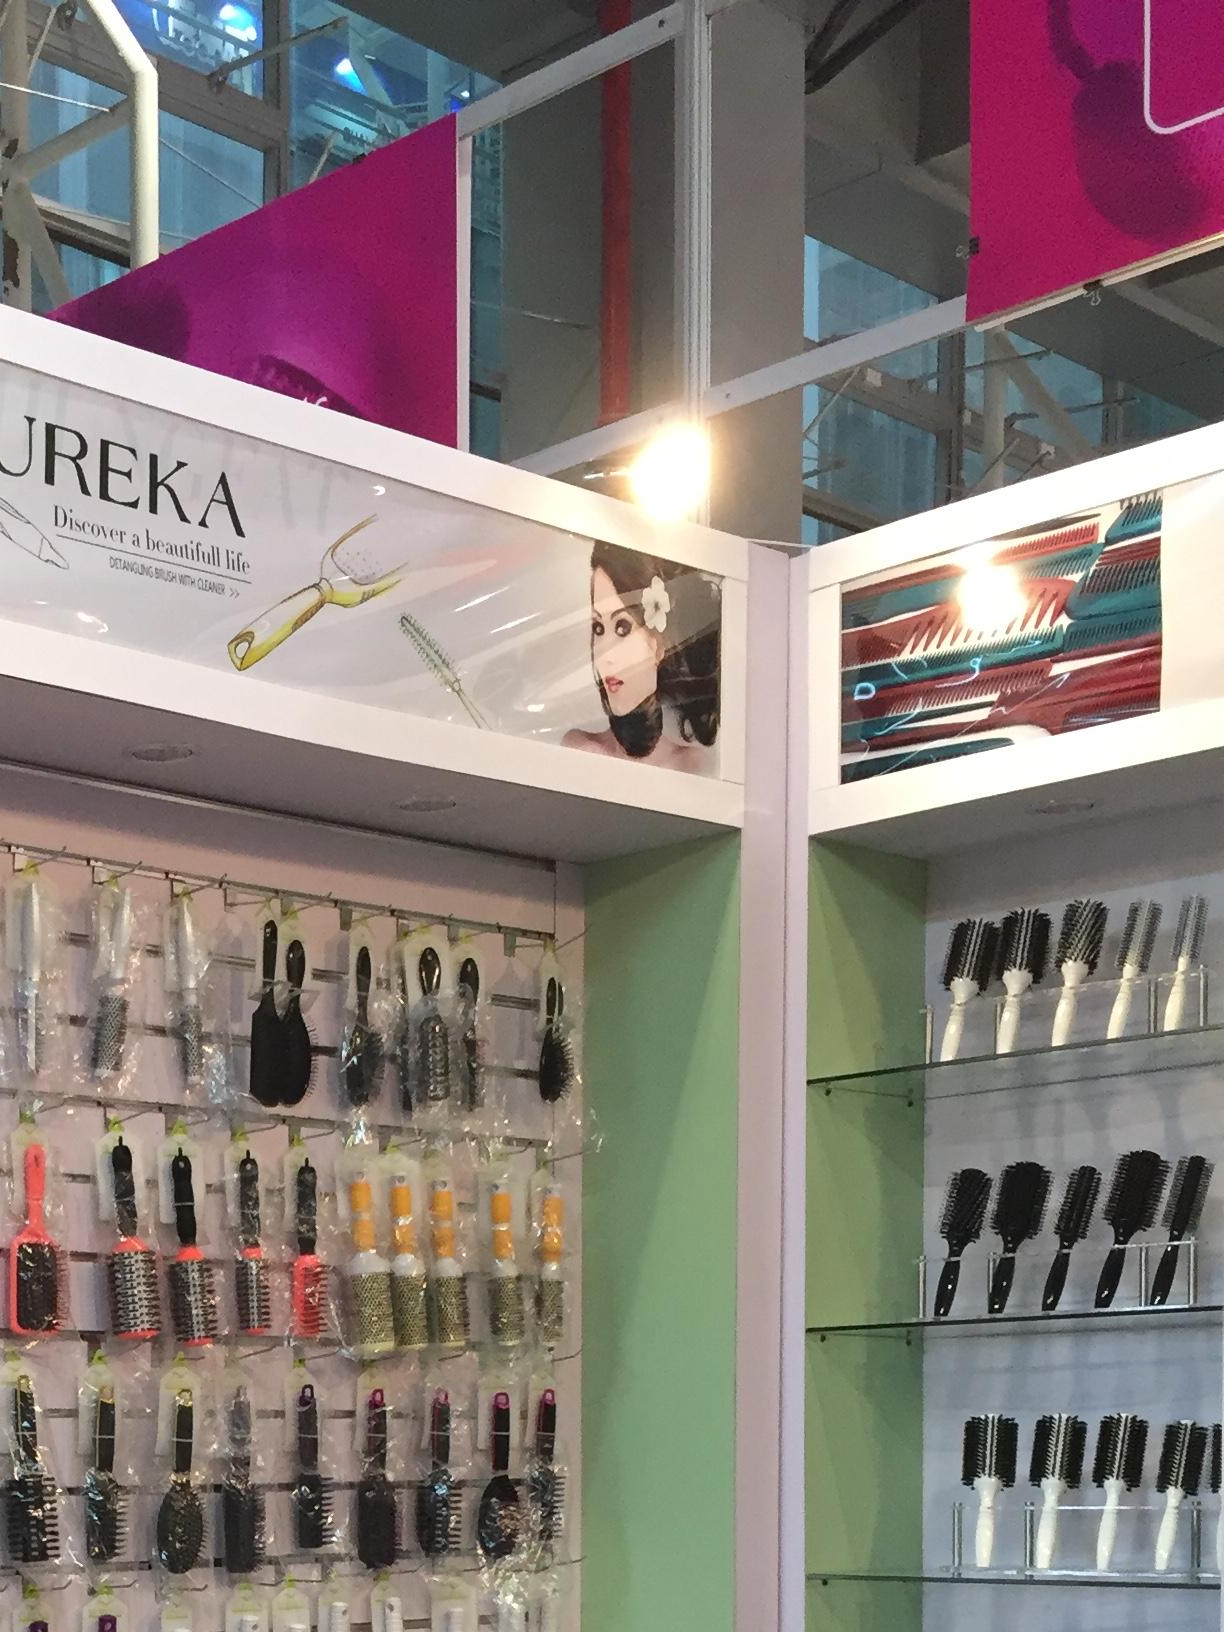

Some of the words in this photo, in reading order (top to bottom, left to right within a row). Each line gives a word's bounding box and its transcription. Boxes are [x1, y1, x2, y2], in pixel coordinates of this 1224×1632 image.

[53, 504, 127, 544] Discover
[131, 532, 141, 549] a
[145, 528, 221, 568] beautifull
[225, 548, 251, 575] life
[109, 556, 154, 579] DETANGLING
[155, 567, 177, 583] BRUSH
[178, 573, 196, 587] WITH
[197, 577, 226, 596] CLEANER
